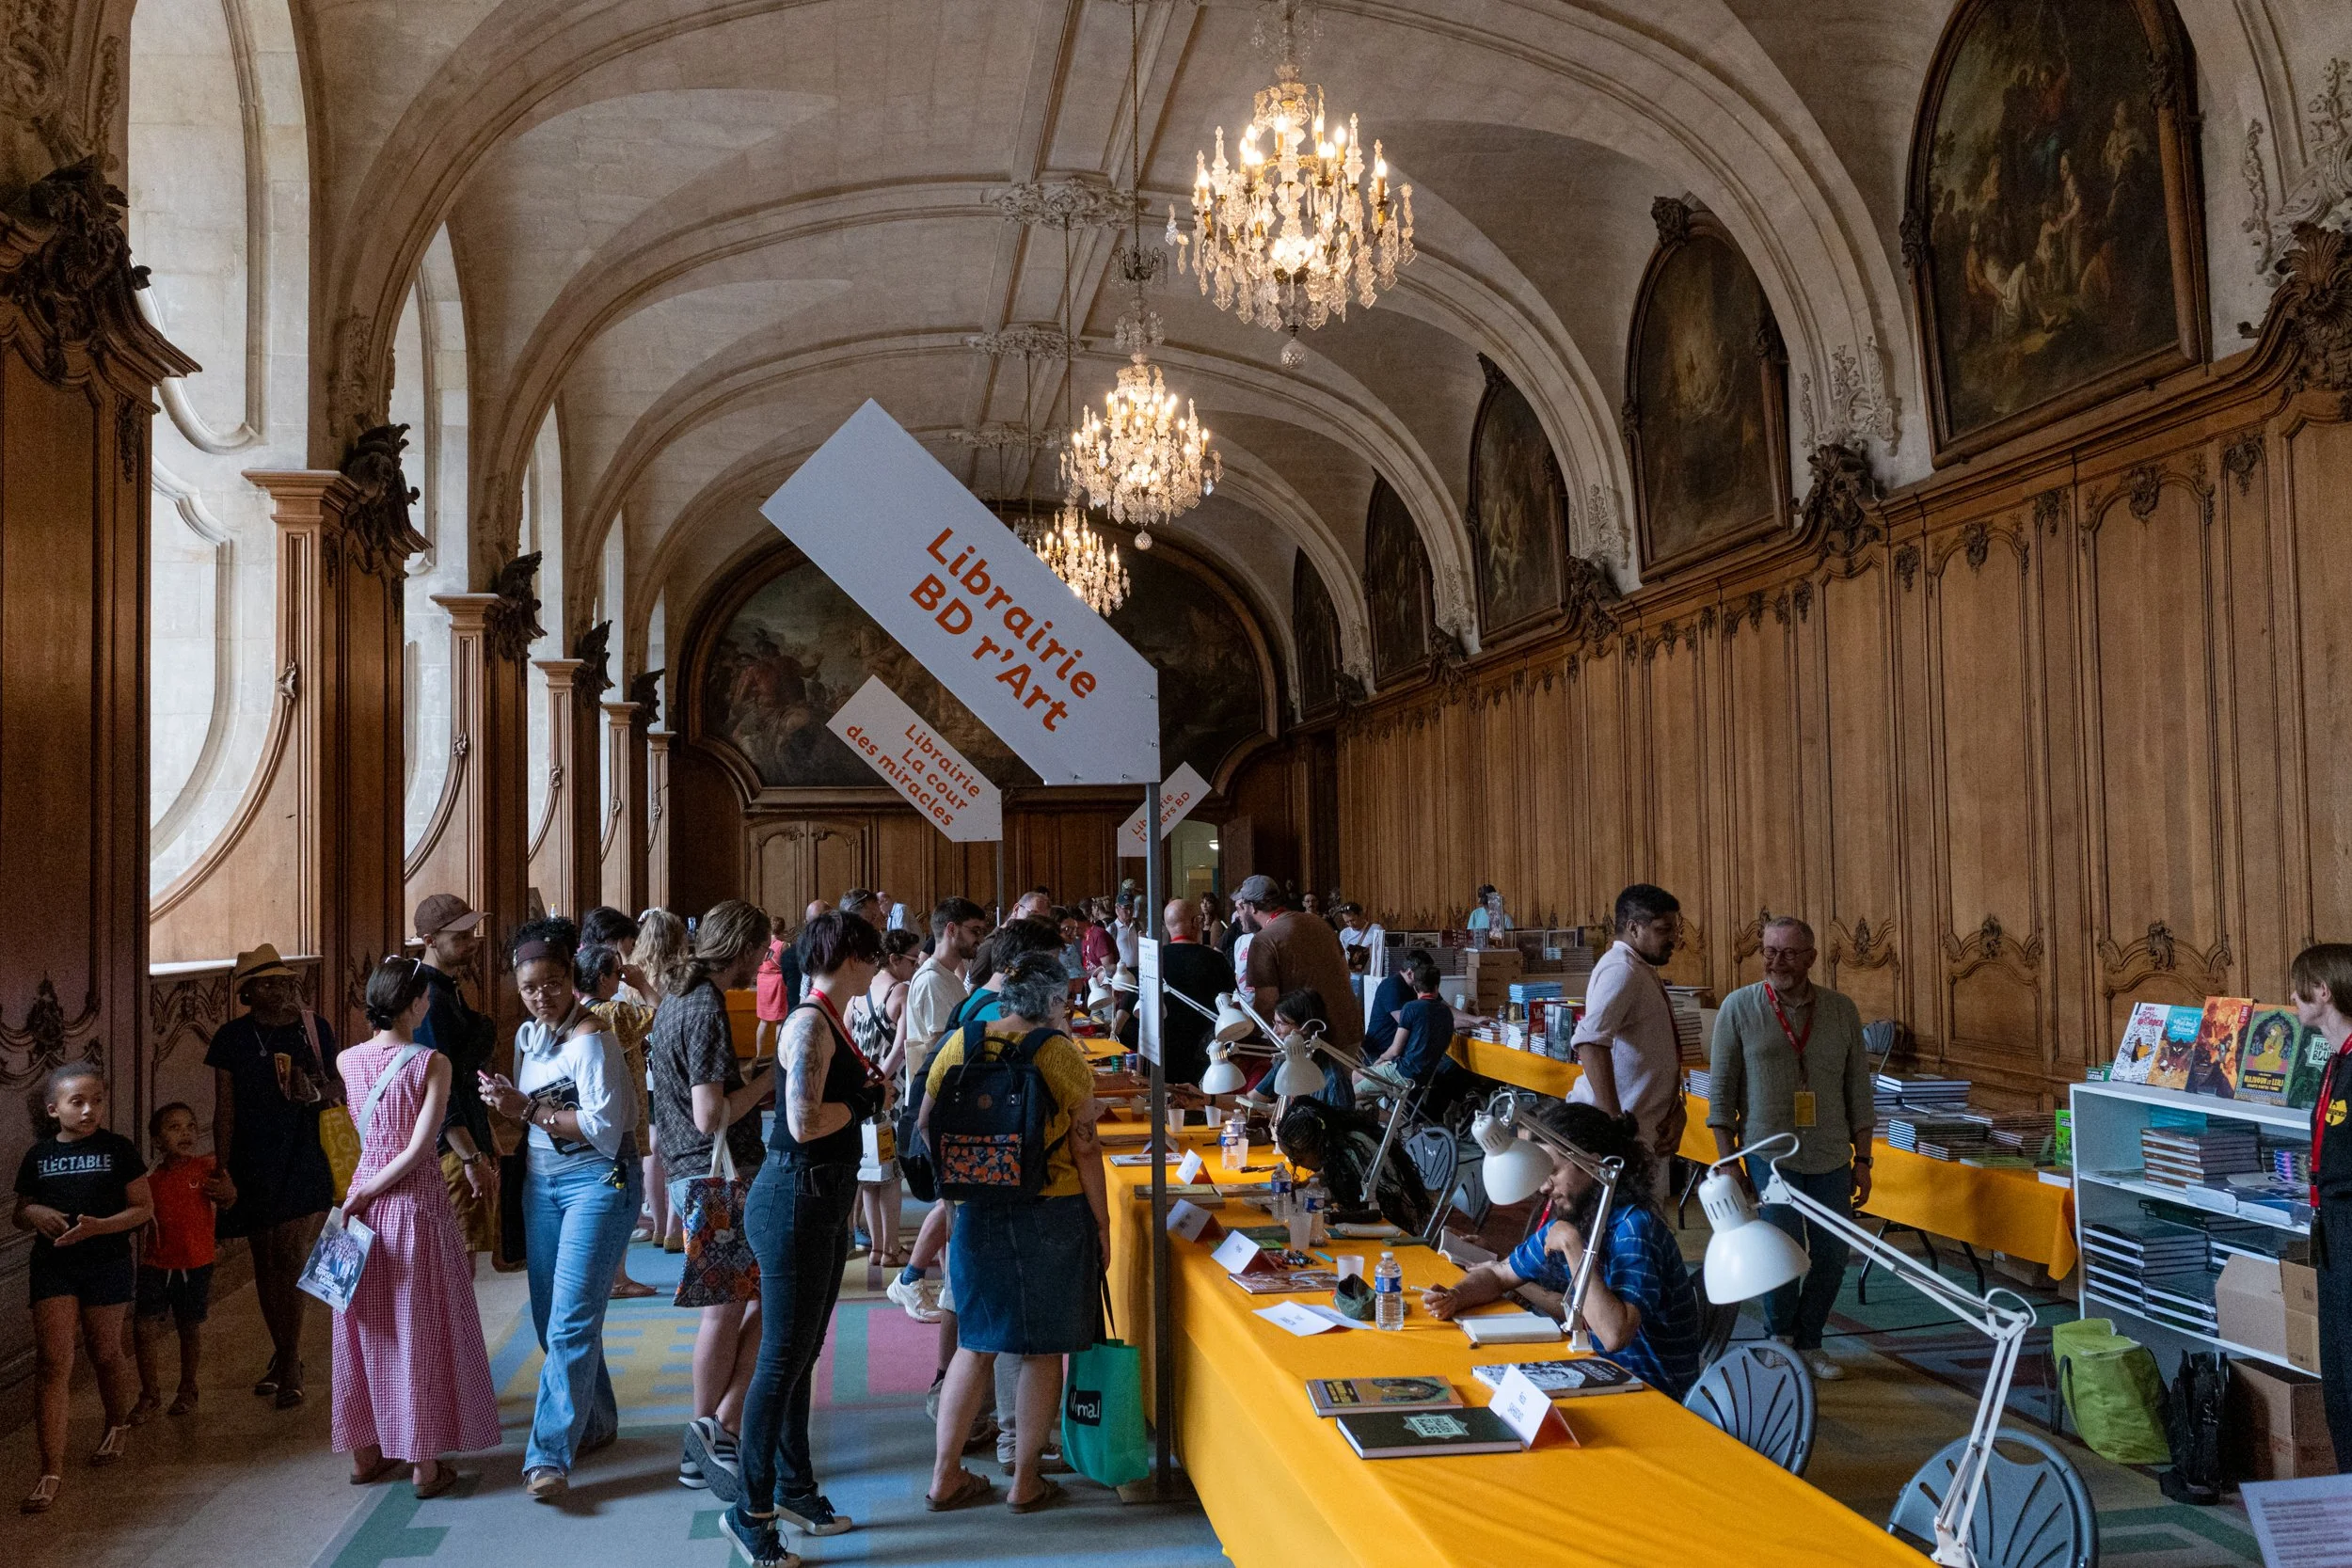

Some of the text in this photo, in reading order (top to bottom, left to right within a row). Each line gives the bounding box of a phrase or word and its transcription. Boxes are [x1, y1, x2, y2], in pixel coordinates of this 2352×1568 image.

[928, 528, 1098, 699] Librairie
[910, 574, 1069, 732] BD r'Art
[846, 725, 954, 826] des miracles
[901, 748, 968, 811] La cour
[904, 723, 980, 798] Librairie
[1132, 793, 1174, 835] Librie
[1139, 791, 1190, 843] Uers BD
